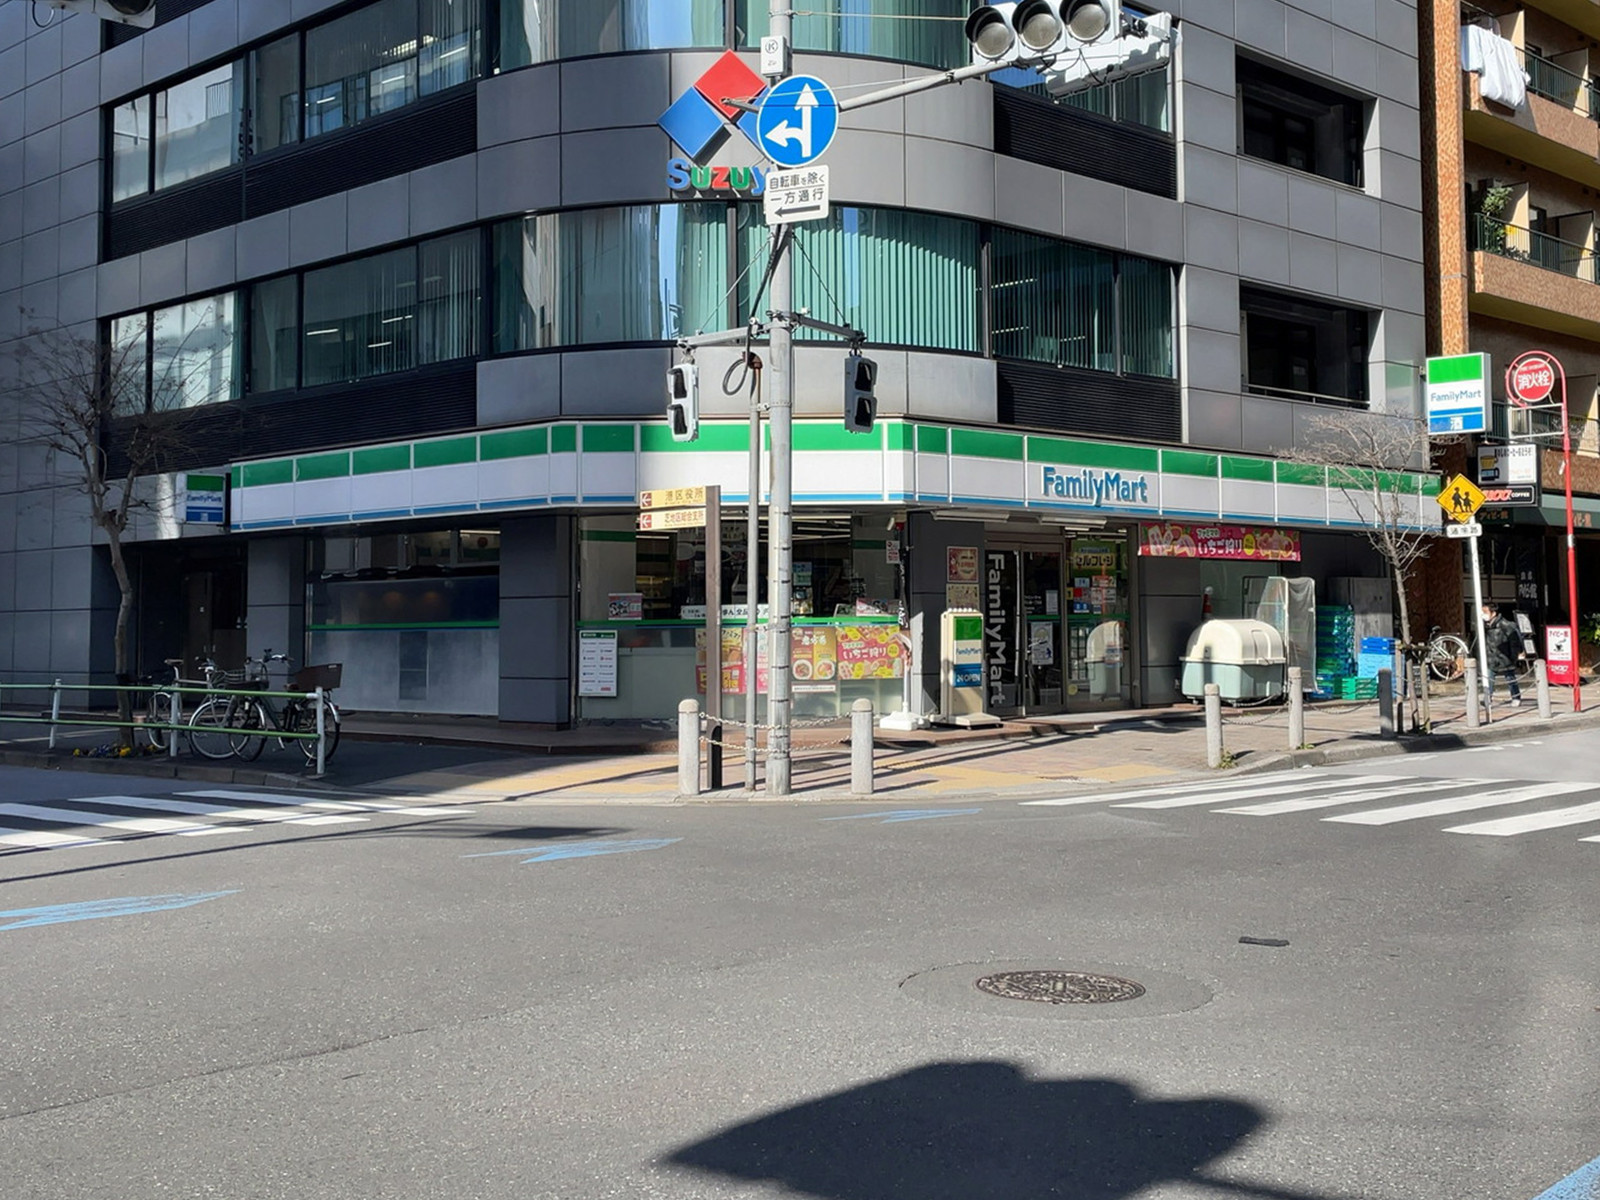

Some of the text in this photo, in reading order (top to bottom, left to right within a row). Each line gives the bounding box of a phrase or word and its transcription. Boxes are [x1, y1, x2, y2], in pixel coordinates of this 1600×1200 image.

[769, 172, 826, 190] 自転車を除く
[770, 187, 824, 205] 一方通行
[1518, 370, 1551, 391] 消火栓
[1430, 388, 1482, 404] FamilyMart
[1450, 415, 1463, 430] 酒
[1042, 466, 1148, 508] FamilyMart
[1198, 538, 1243, 556] いちご狩り
[985, 553, 1007, 705] FamilyMart
[843, 647, 887, 659] いちご狩り
[956, 648, 982, 656] FamilyMart
